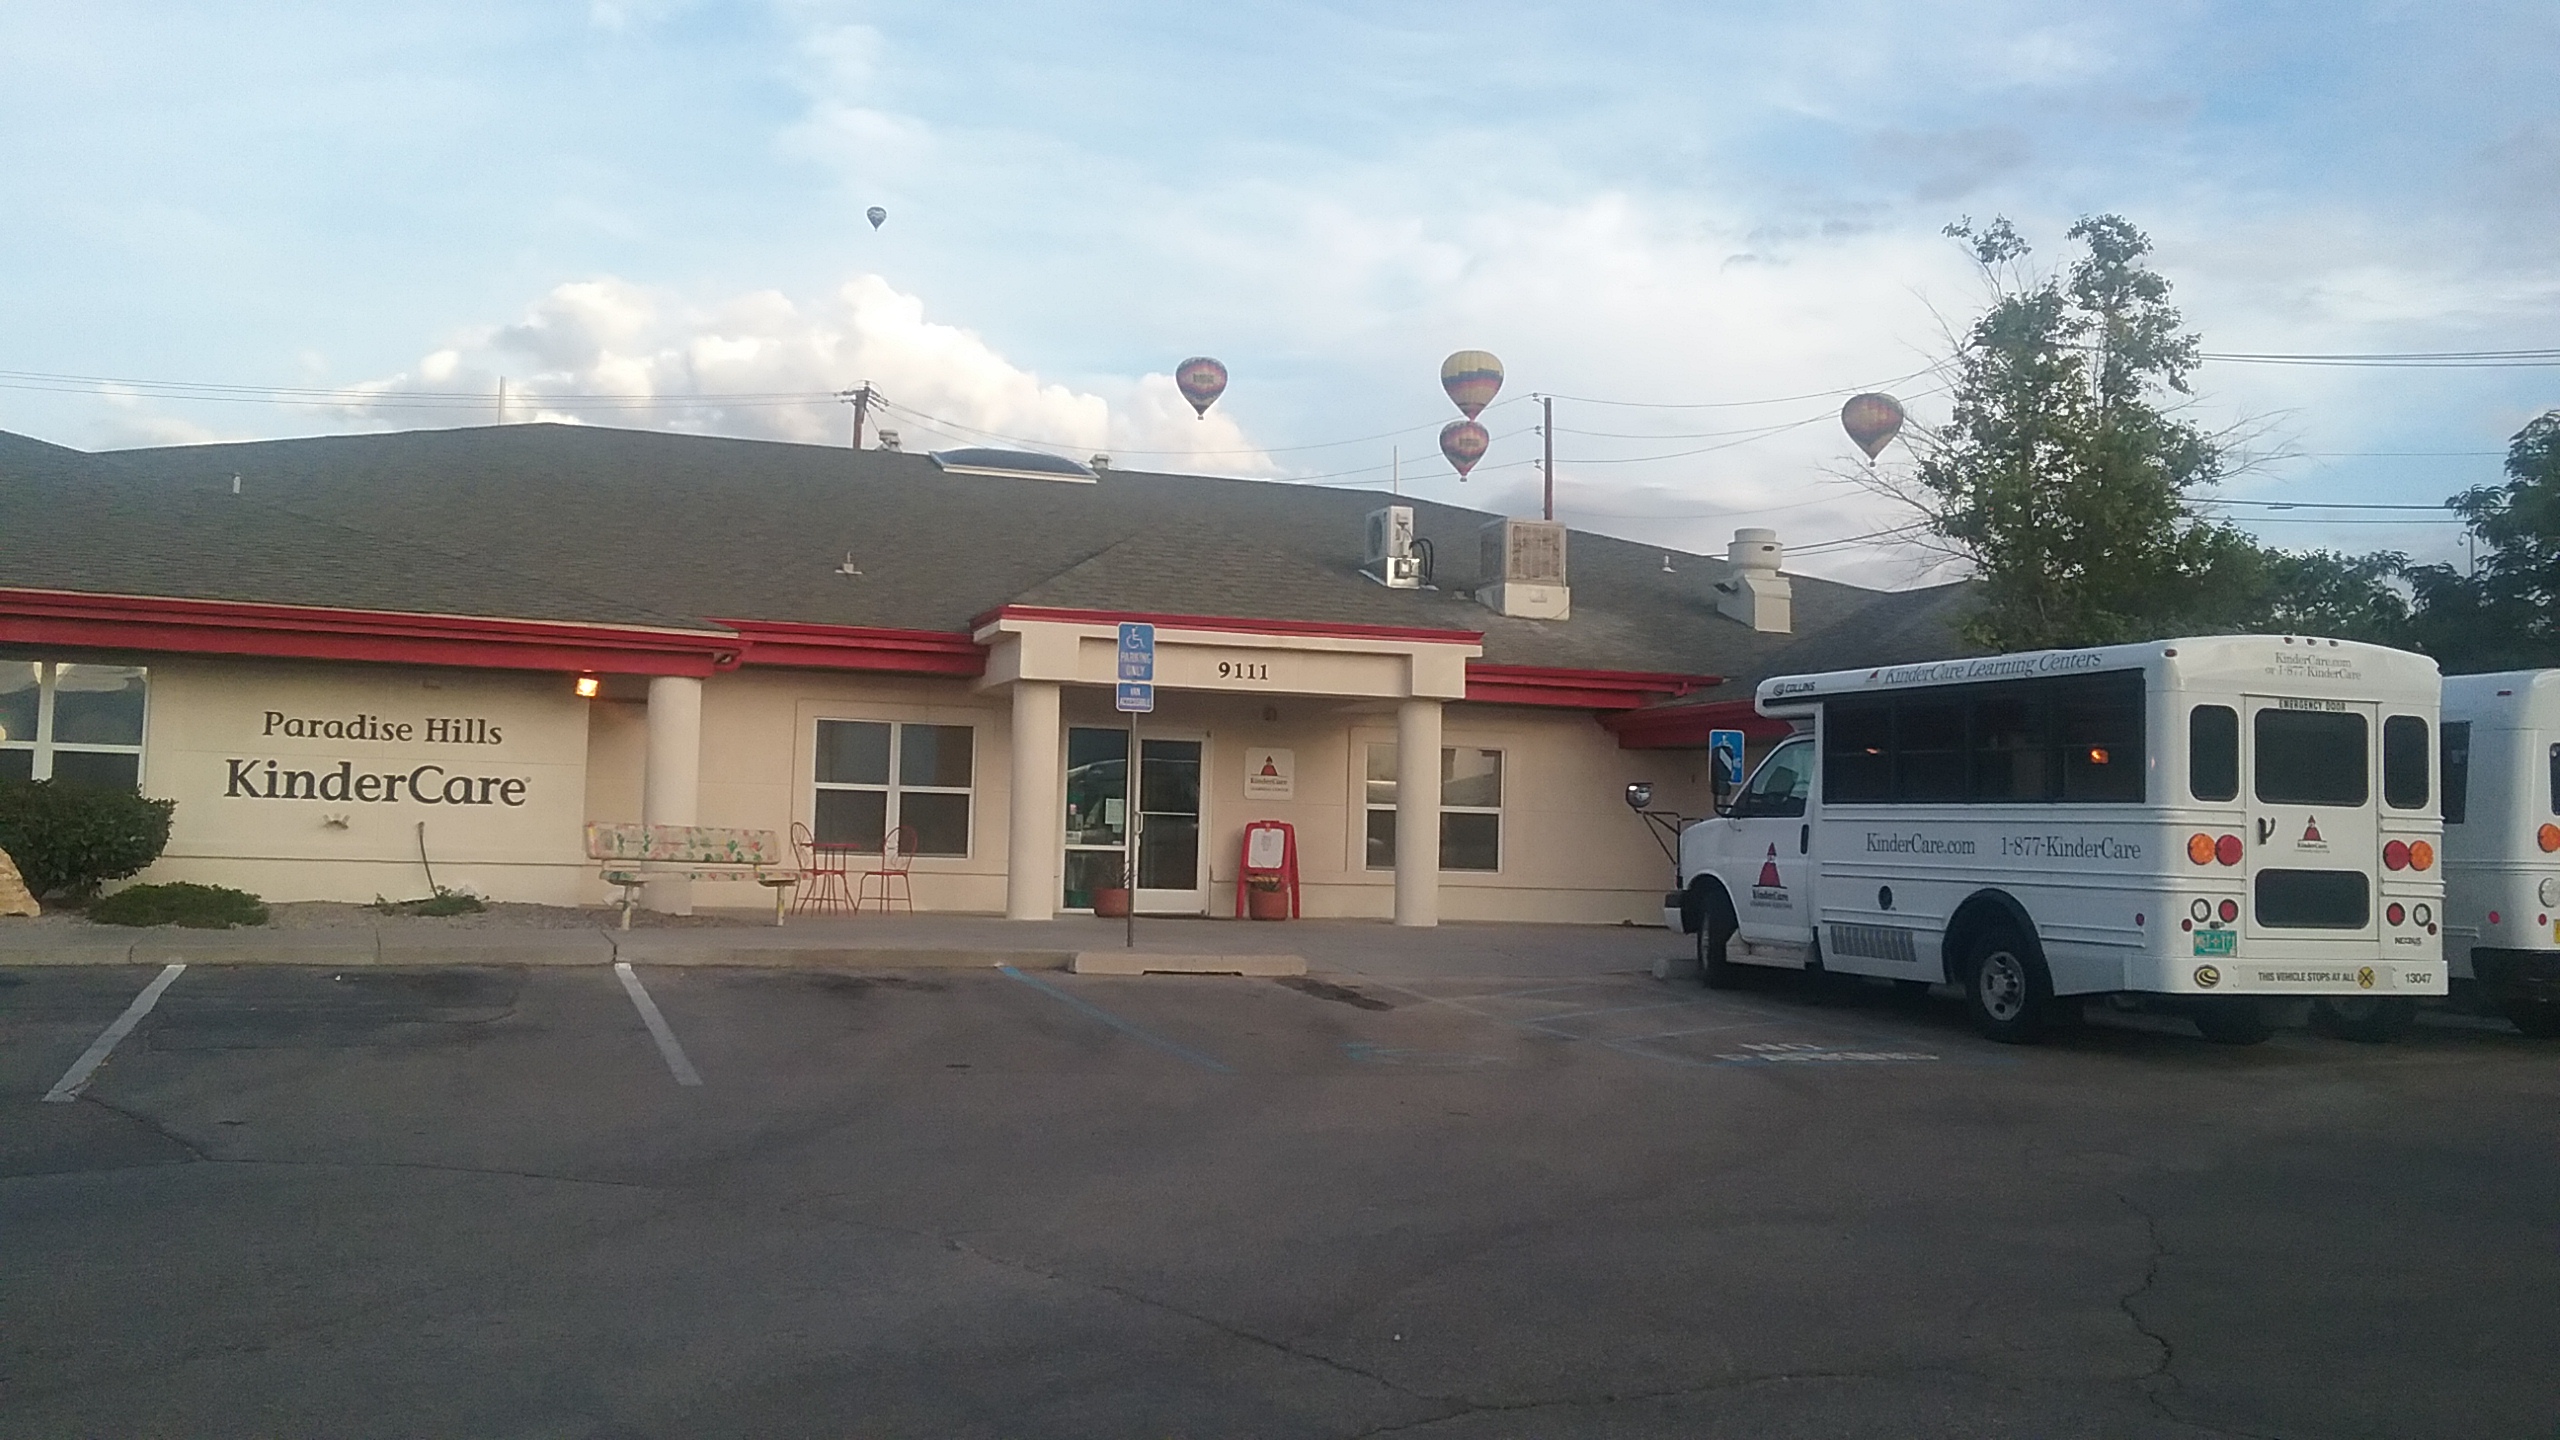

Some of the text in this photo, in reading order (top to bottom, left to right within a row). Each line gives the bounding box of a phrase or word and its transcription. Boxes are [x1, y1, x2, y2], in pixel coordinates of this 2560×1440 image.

[1120, 652, 1152, 664] PARKING
[1126, 665, 1146, 676] ONLY
[1218, 661, 1268, 680] 9111
[1883, 651, 2103, 684] KinderCare Learning Centers
[1785, 681, 1816, 693] COLLINS
[2279, 700, 2346, 711] EMERGENCY DOOR
[262, 711, 503, 745] Paradise Hills
[224, 758, 528, 807] KinderCare
[1866, 832, 2142, 860] KinderCare.com 1-877-KinderCare
[2258, 972, 2355, 983] THIS VEHICLE STOPS AT ALL
[2405, 972, 2432, 984] 13047
